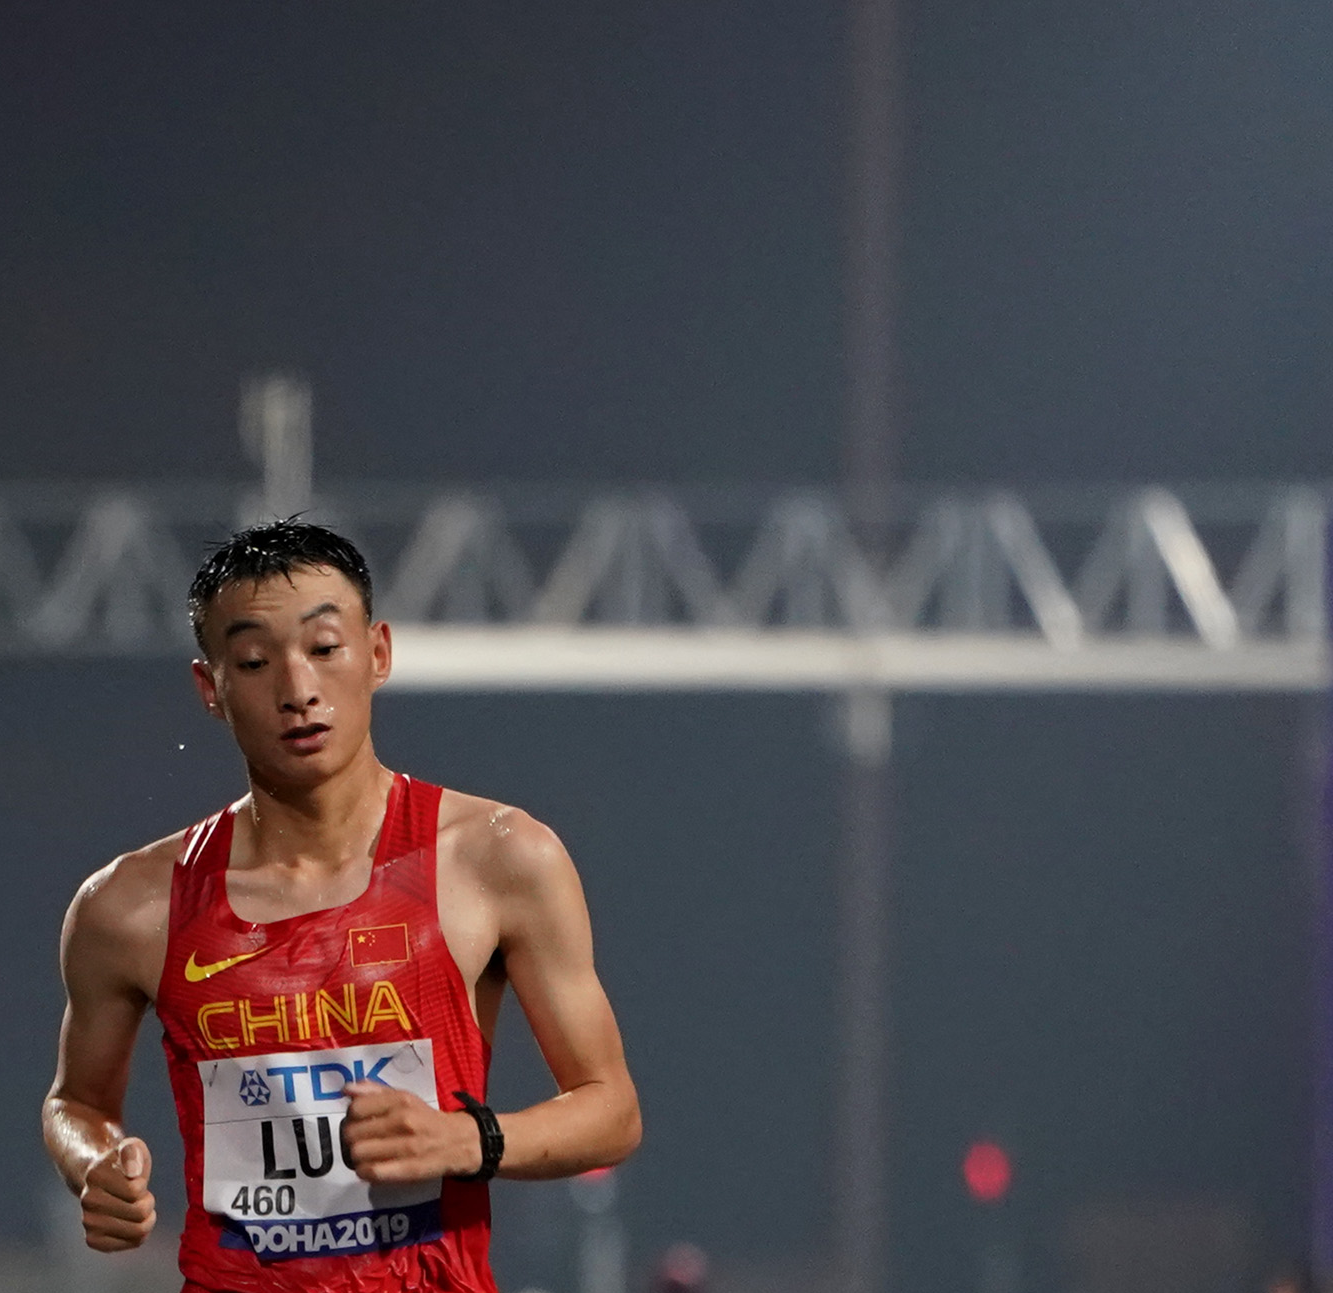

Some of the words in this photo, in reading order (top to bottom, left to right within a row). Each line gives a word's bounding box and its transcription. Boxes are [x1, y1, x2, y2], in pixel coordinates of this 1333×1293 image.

[197, 980, 412, 1050] CHINA
[267, 1056, 394, 1105] TDK
[231, 1185, 296, 1216] 460
[245, 1213, 410, 1254] DOHA2019
